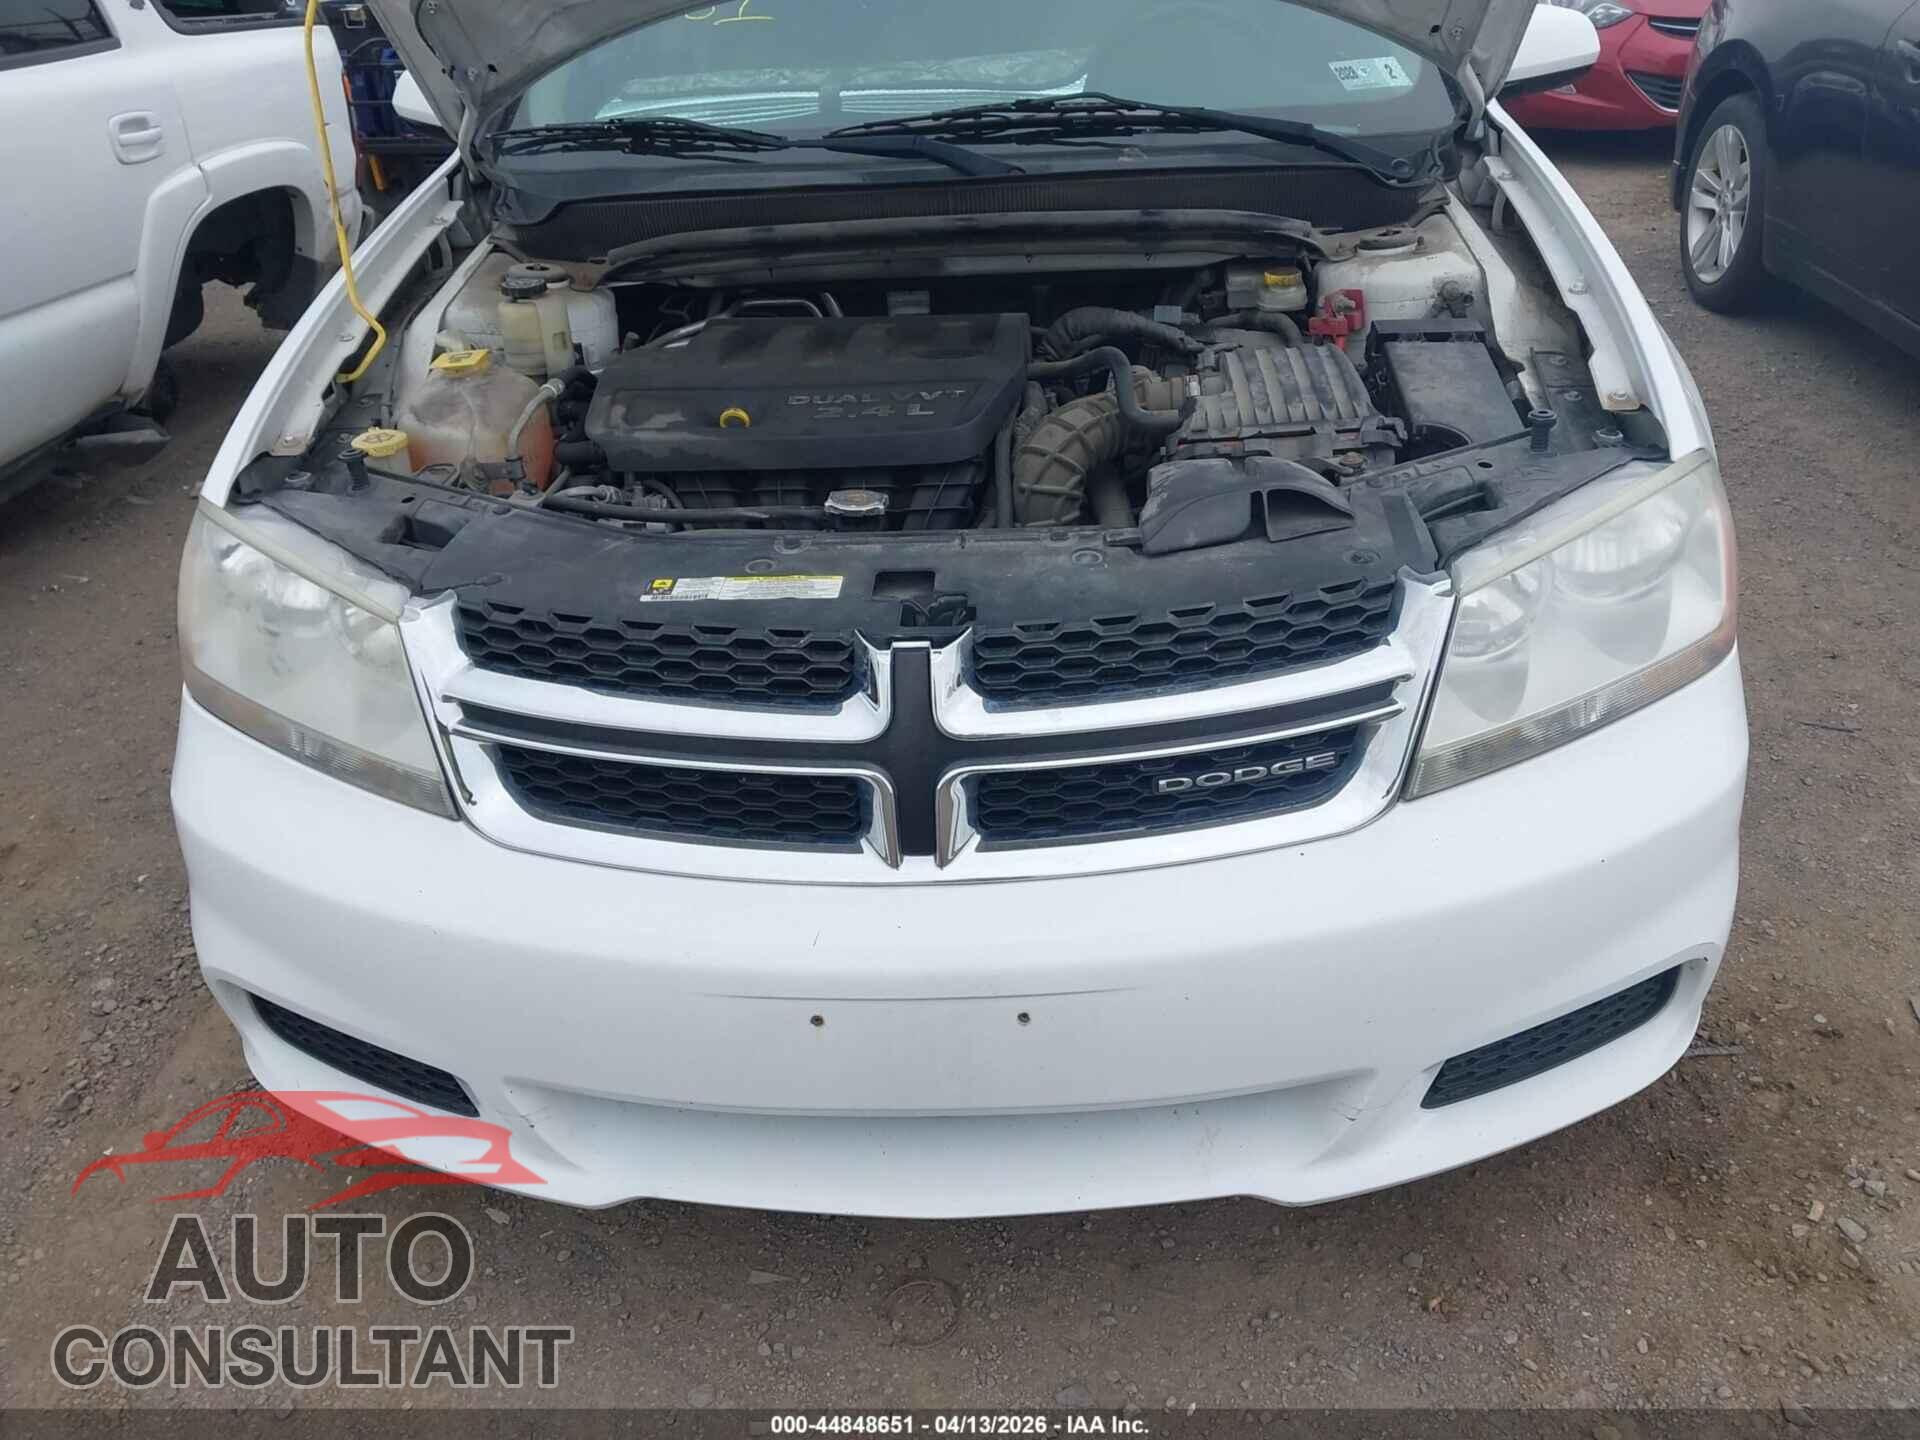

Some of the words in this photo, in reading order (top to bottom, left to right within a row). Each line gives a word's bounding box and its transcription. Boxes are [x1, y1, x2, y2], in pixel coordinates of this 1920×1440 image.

[1384, 63, 1398, 79] 2
[786, 392, 880, 405] DUAL
[1157, 751, 1336, 793] DODGE
